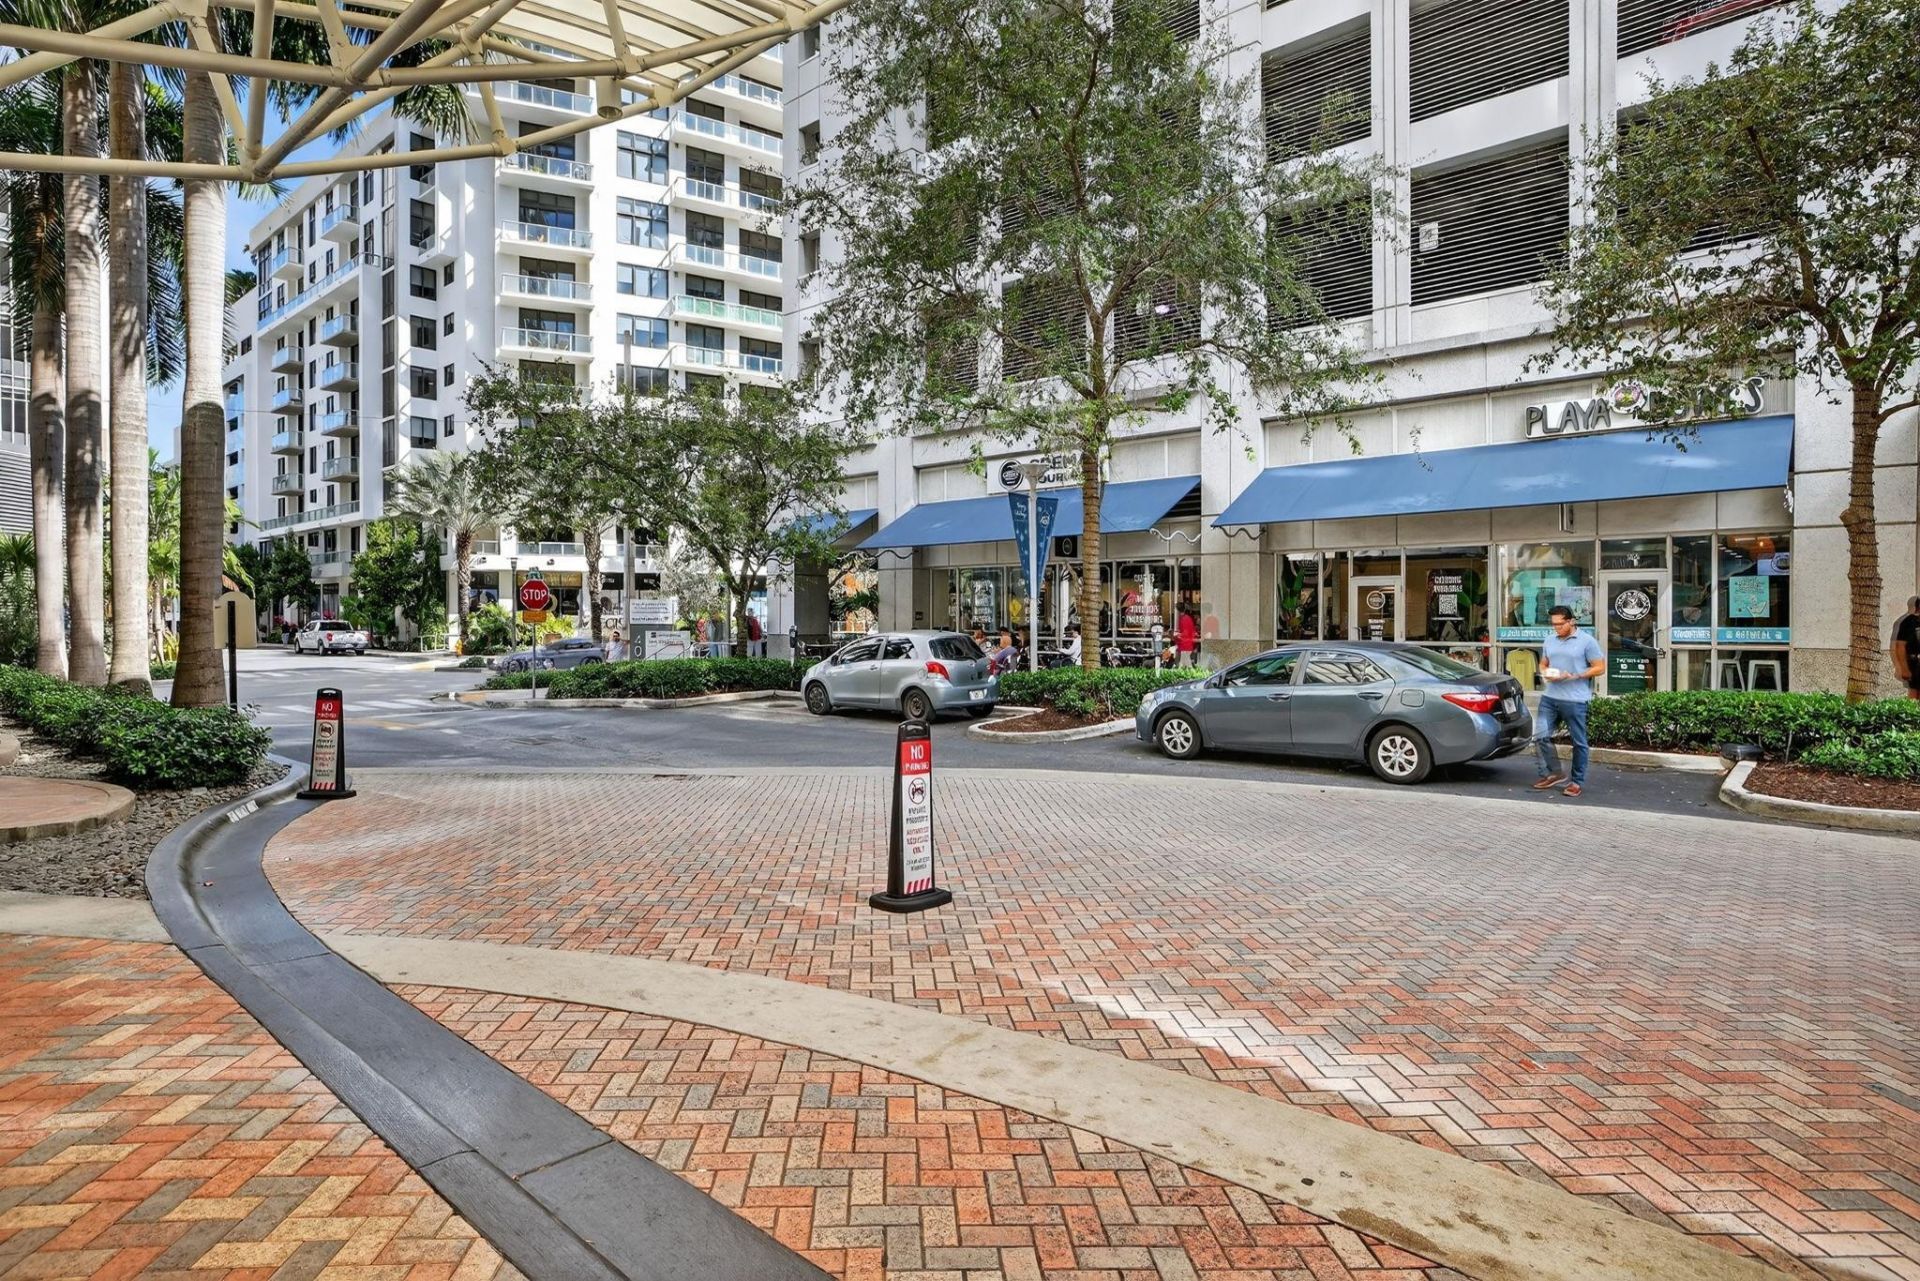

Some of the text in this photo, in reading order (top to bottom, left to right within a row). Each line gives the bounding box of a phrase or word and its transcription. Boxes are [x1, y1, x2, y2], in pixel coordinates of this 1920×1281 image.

[1525, 398, 1611, 436] PLAYA
[522, 589, 547, 600] STOP
[321, 702, 333, 711] NO
[911, 745, 924, 760] NO
